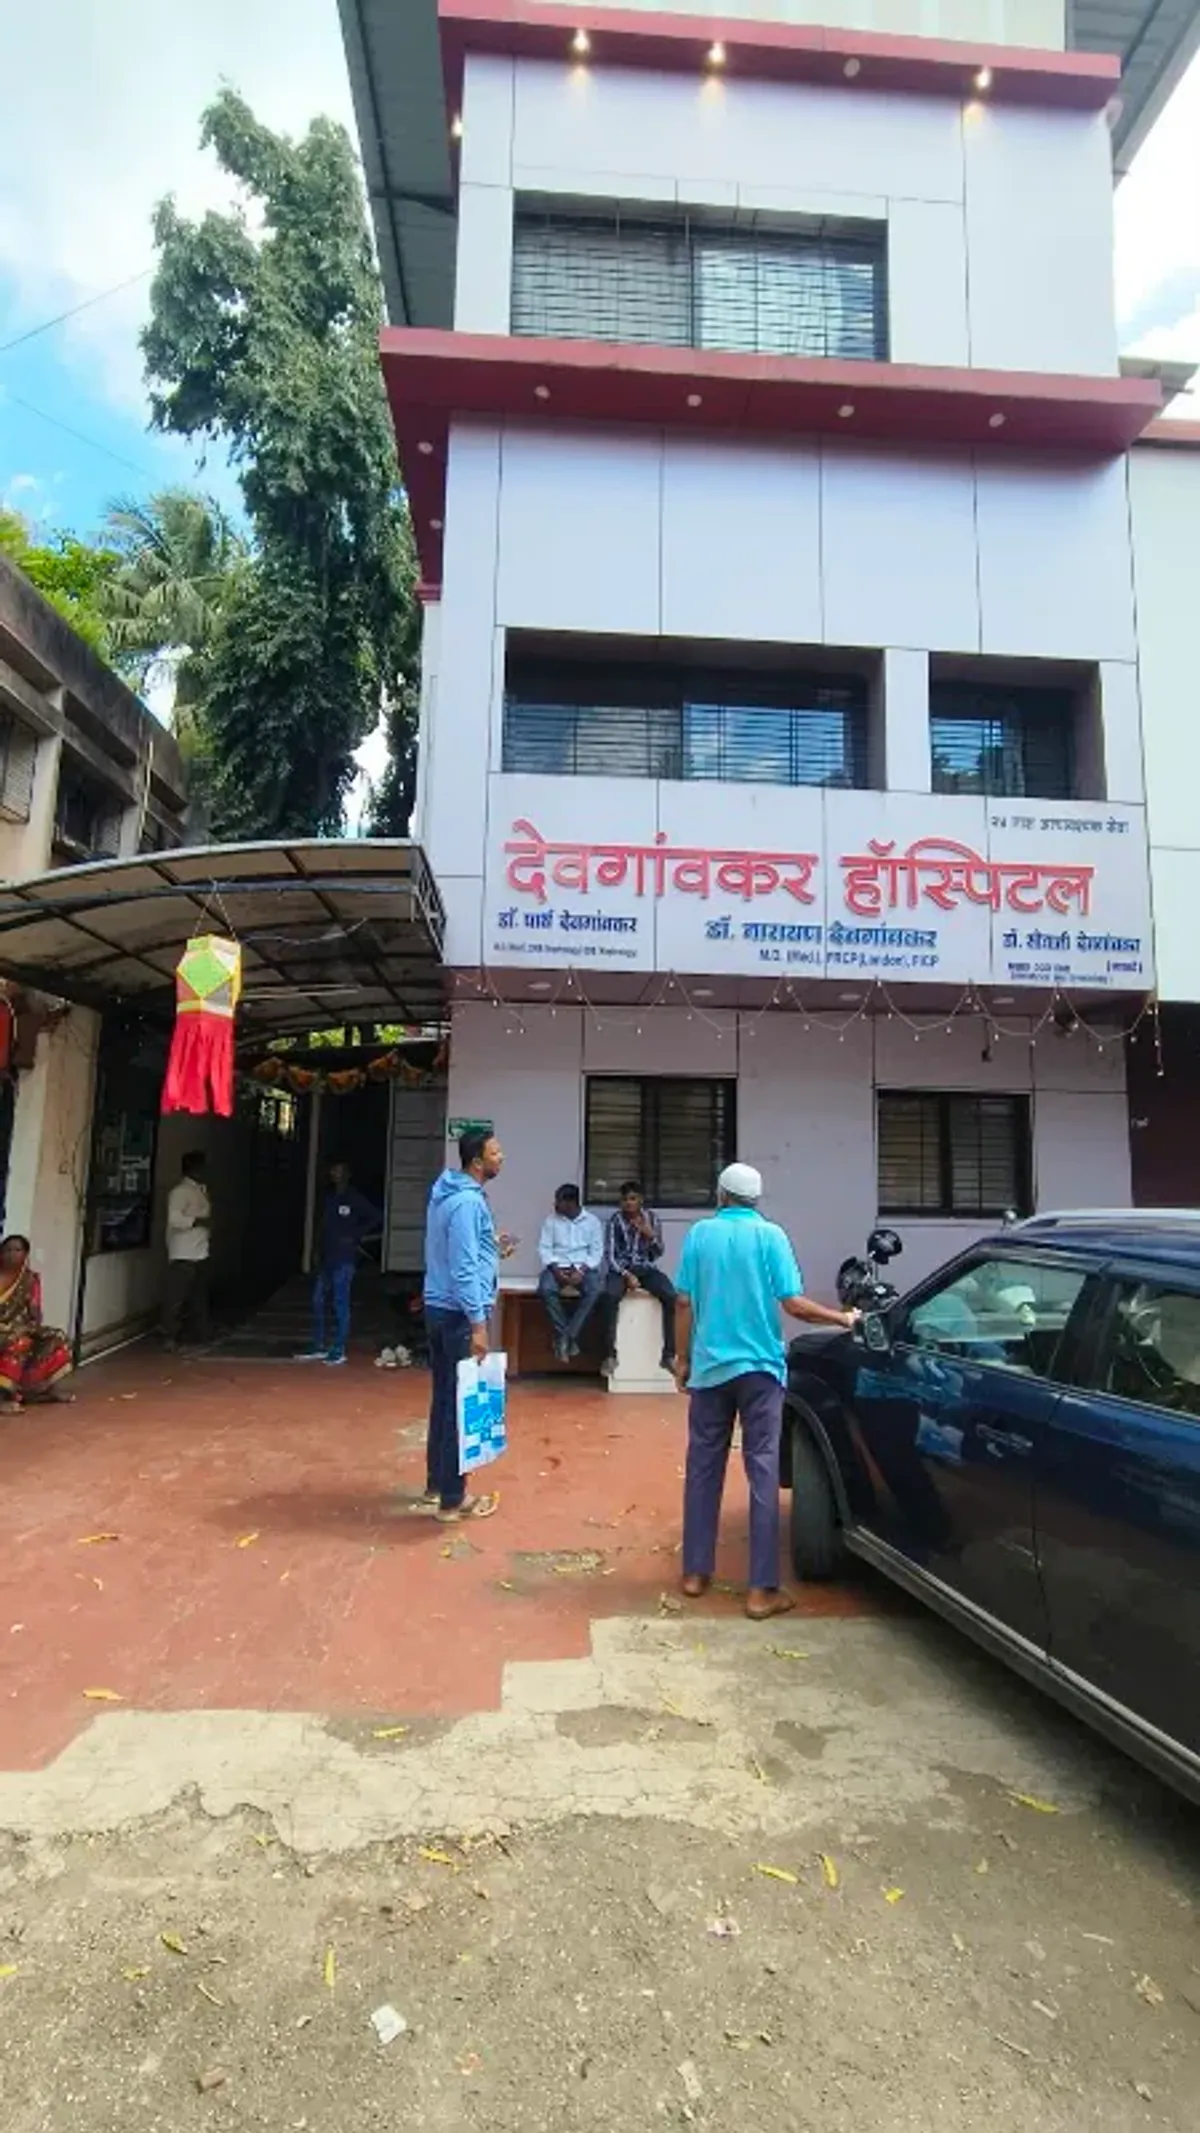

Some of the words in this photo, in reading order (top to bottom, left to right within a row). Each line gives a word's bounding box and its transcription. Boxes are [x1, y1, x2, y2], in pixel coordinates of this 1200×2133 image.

[503, 818, 820, 905] देवगांवकर
[839, 837, 1096, 918] हॉस्पिटल
[498, 906, 519, 930] डॉ.
[705, 914, 735, 941] डॉ.
[743, 922, 822, 945] नारायण
[827, 920, 938, 949] देवगांवकर
